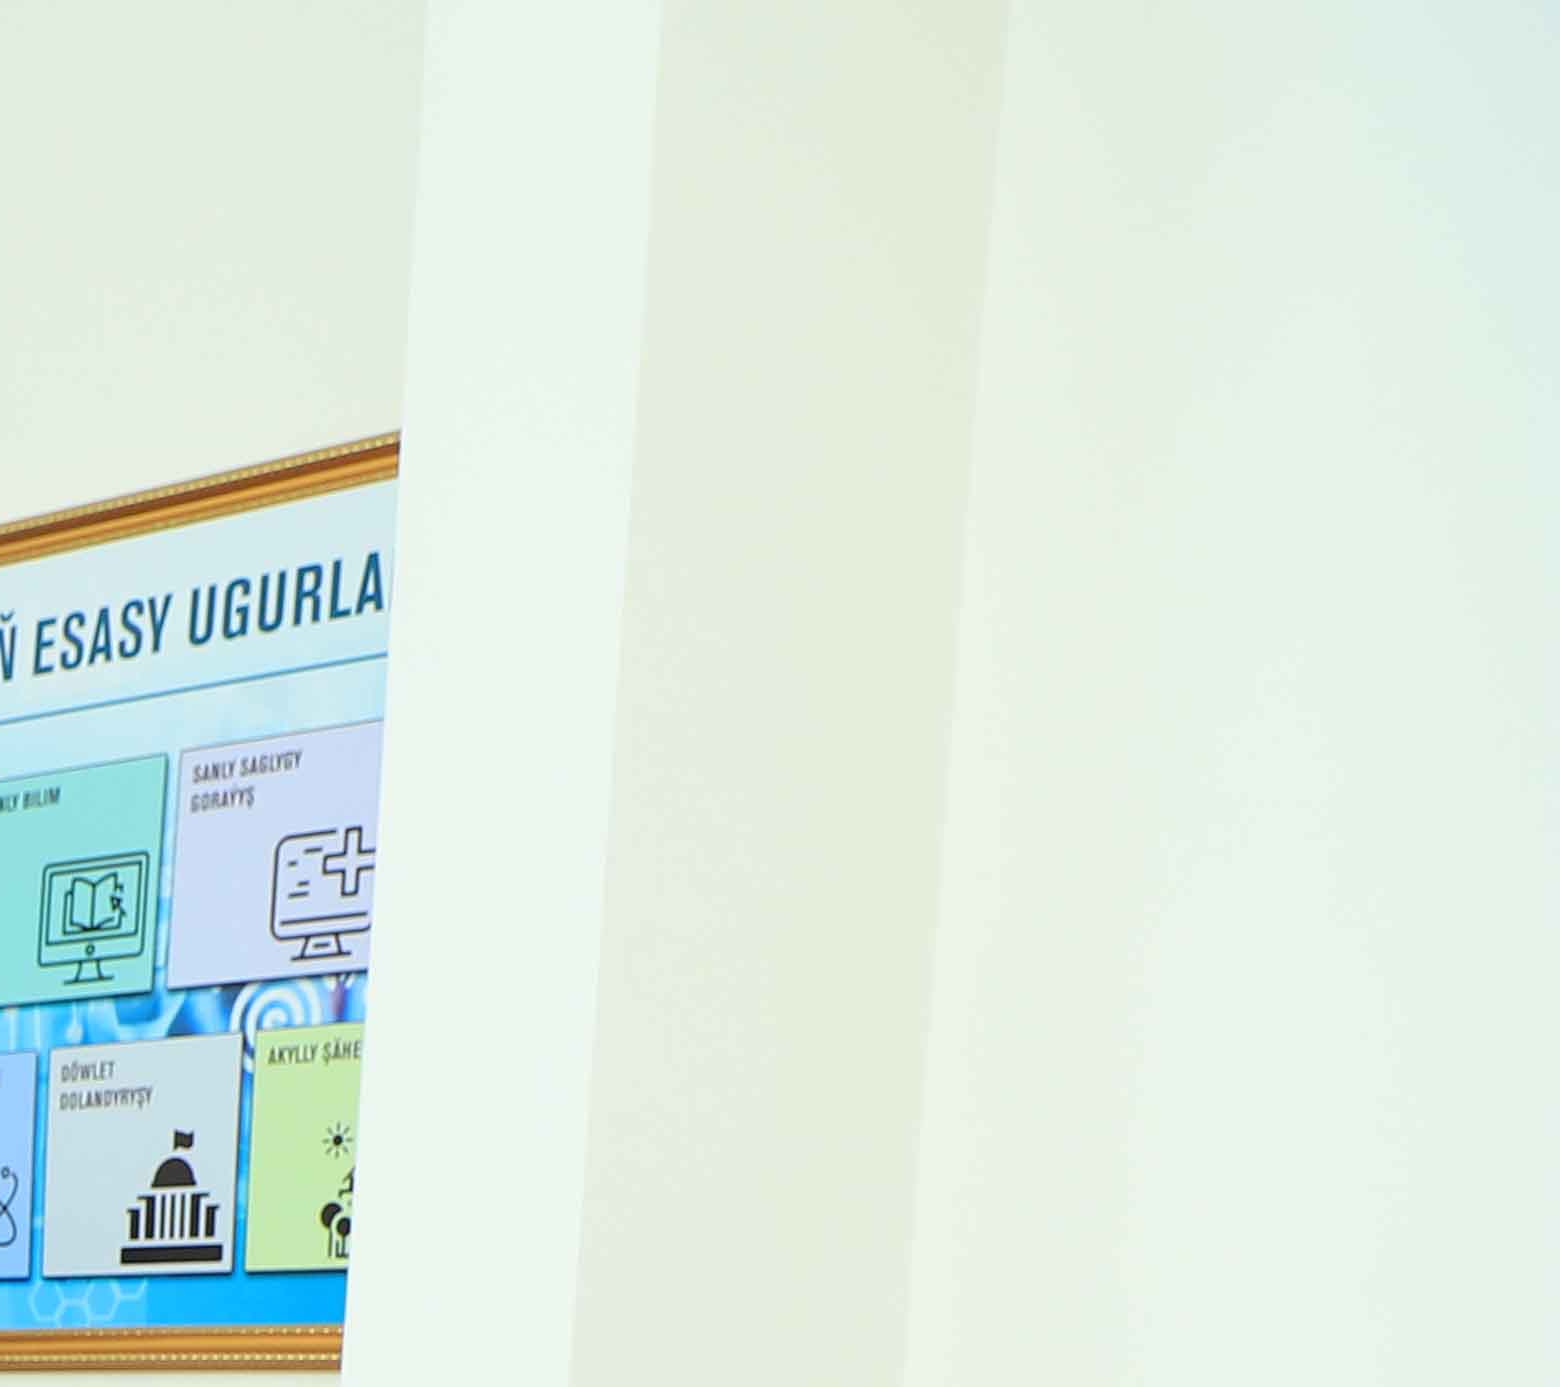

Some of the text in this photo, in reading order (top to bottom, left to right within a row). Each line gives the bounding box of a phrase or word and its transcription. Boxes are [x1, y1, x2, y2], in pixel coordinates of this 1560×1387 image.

[32, 593, 173, 675] ESASY
[188, 551, 385, 647] UGURLA
[193, 750, 303, 784] SANLY SAGLYGY
[22, 786, 61, 811] BILIM
[268, 1042, 319, 1066] AKYLLY
[60, 1060, 116, 1083] DÖWLET
